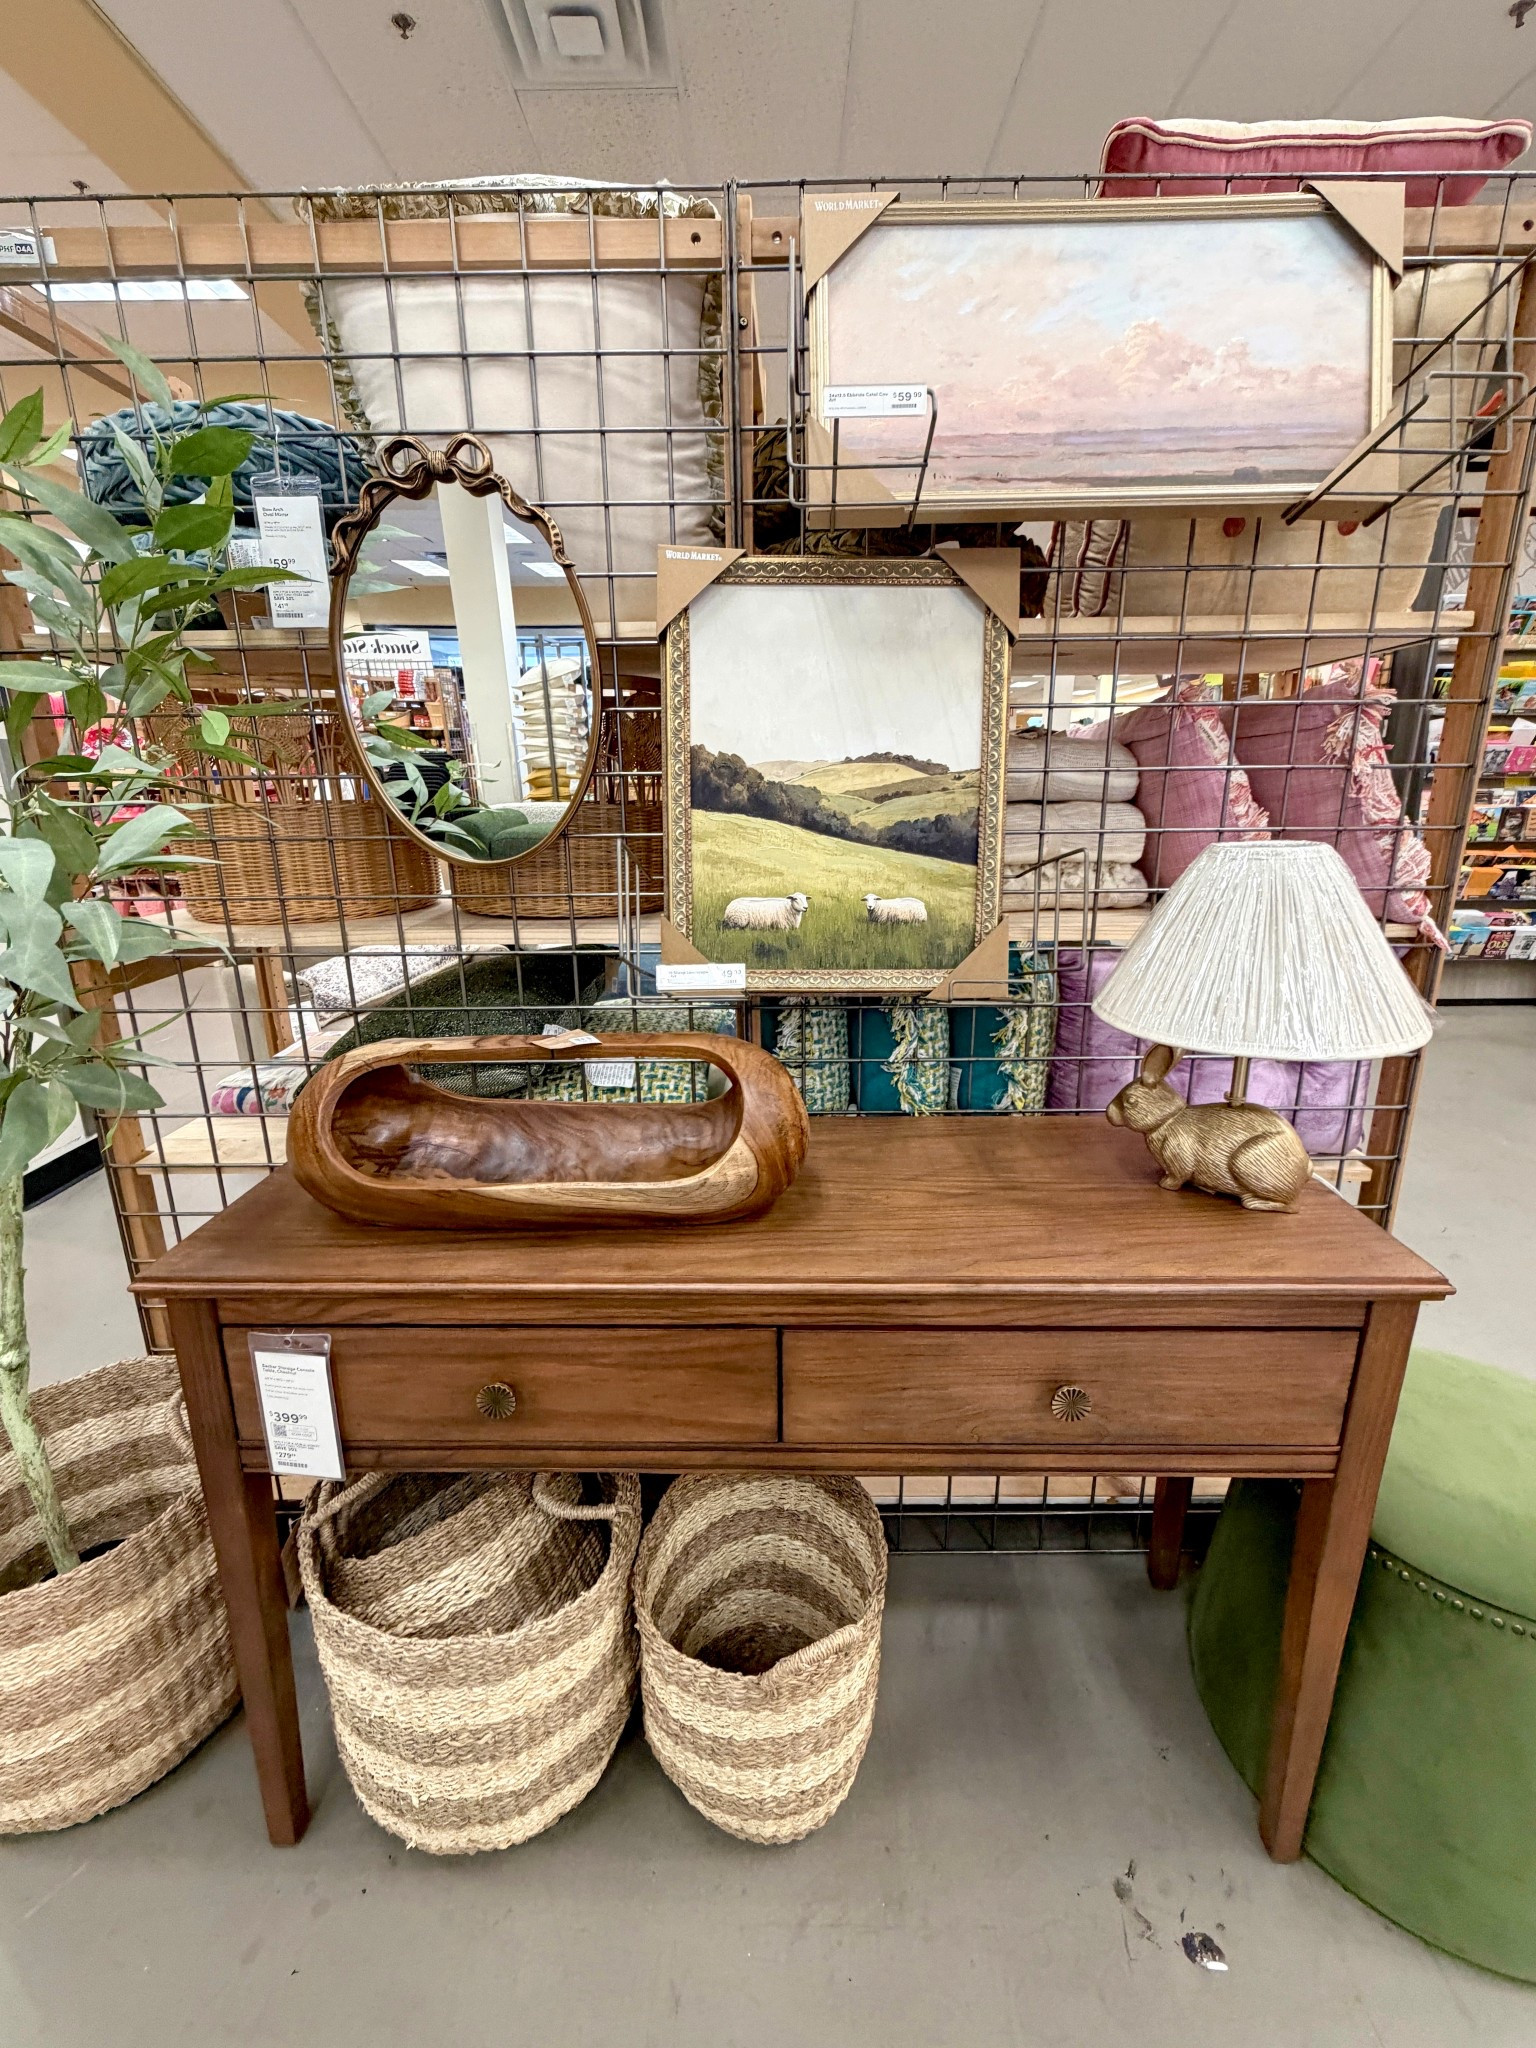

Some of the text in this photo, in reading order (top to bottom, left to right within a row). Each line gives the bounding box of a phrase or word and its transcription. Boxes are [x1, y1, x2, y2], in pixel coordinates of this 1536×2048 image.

[815, 197, 879, 212] WORLD MARKET
[665, 549, 720, 561] WORLD MARKET
[1486, 940, 1508, 950] OLD
